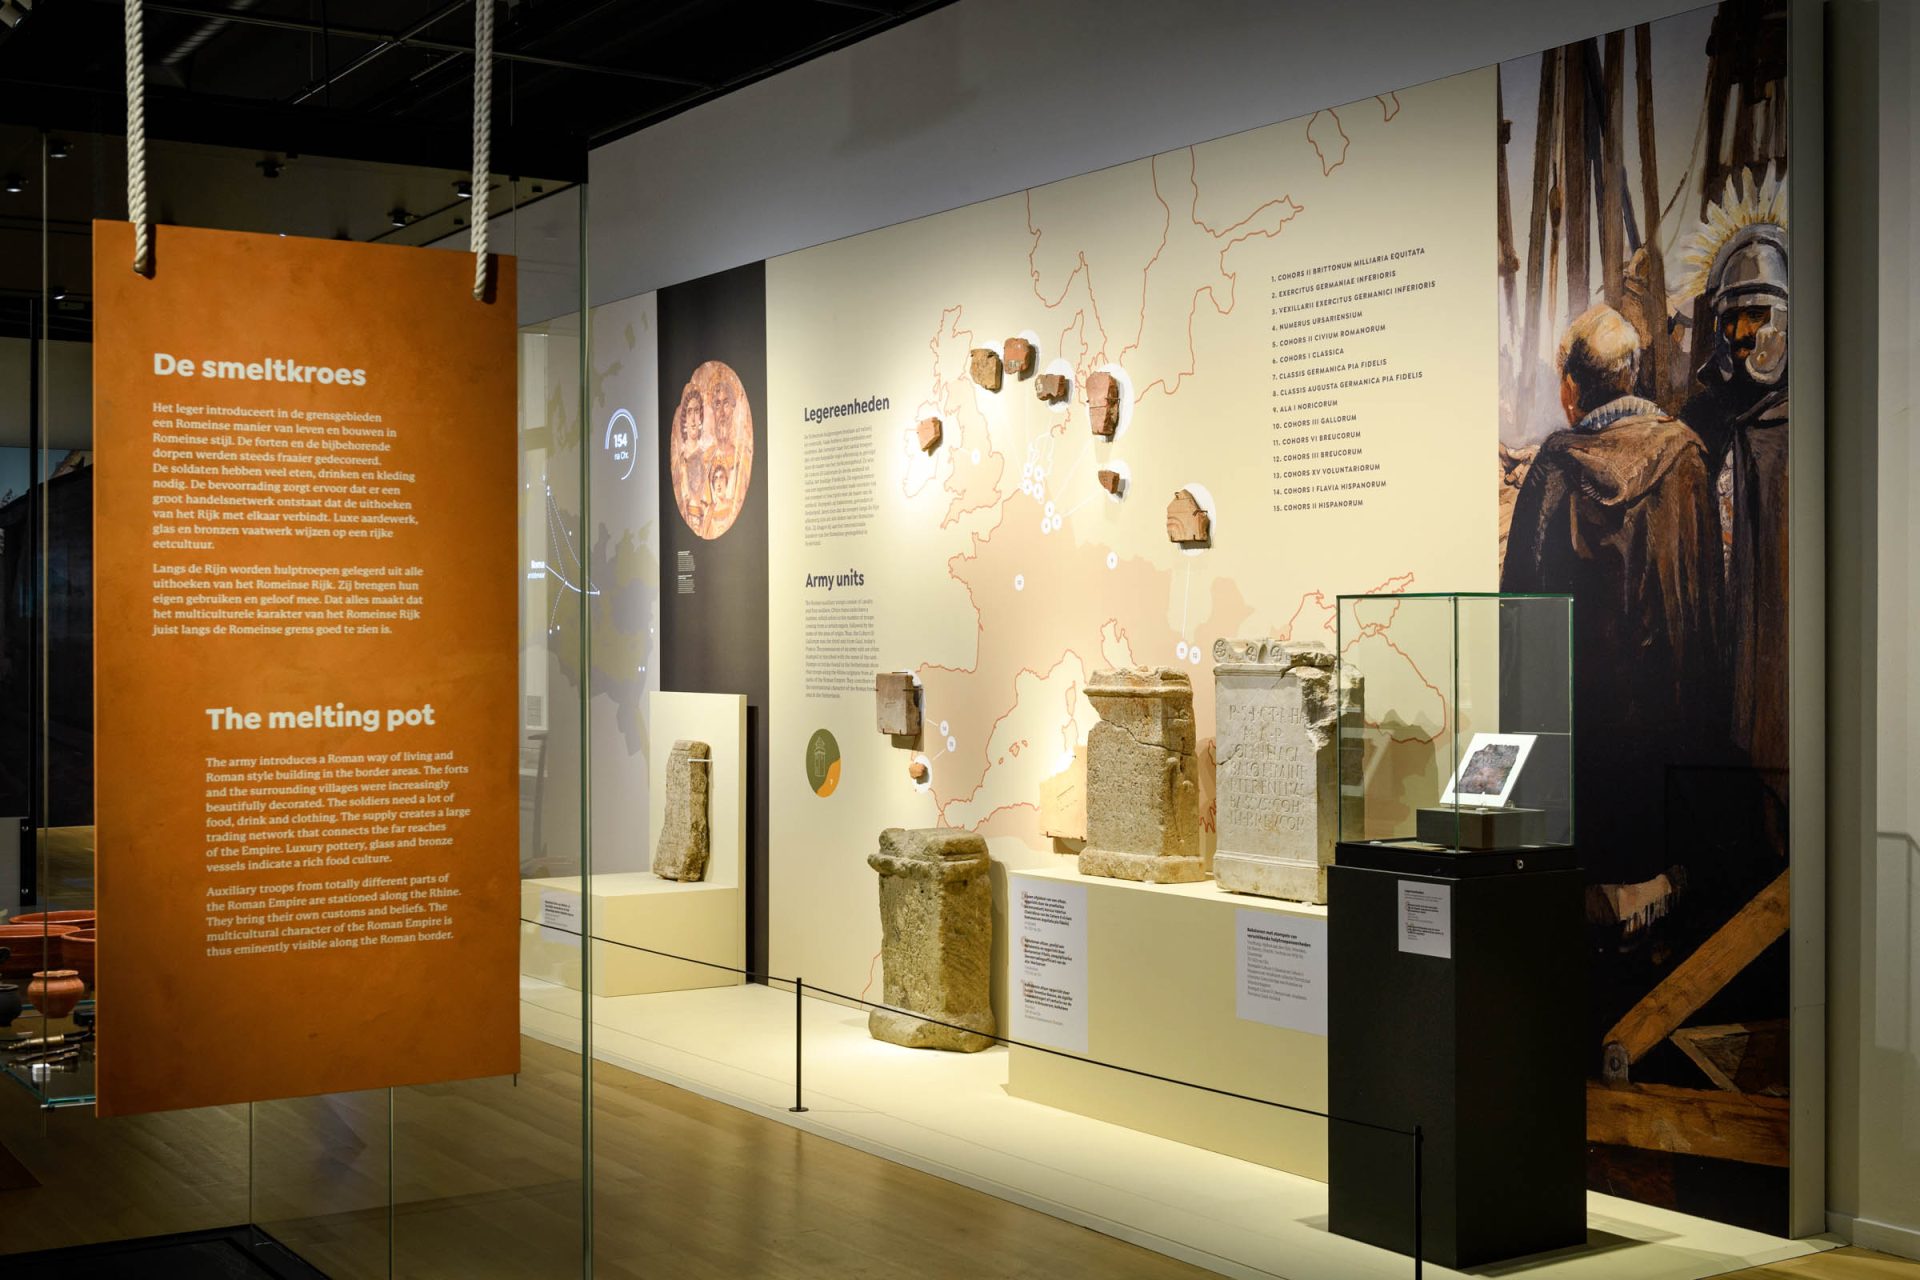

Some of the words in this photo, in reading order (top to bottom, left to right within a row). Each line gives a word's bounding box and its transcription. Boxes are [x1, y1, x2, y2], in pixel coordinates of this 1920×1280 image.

[1277, 270, 1304, 280] COHORS
[1312, 262, 1352, 274] BRITTONUM
[1353, 255, 1388, 266] MILLIARIA
[1390, 249, 1425, 260] EQUITATA
[1278, 286, 1314, 296] EXERCITUS
[1315, 279, 1355, 290] GERMANIAE
[1356, 272, 1396, 283] INFERIORIS
[1278, 302, 1314, 313] VEXILLARII
[1315, 296, 1352, 307] EXERCITUS
[1353, 289, 1392, 300] GERMANICI
[1394, 282, 1435, 294] INFERIORIS
[1279, 320, 1310, 330] NUMERUS
[1312, 312, 1362, 324] URSARIENSIUM
[1279, 337, 1306, 346] COHORS
[1314, 332, 1338, 341] CIVIUM
[1340, 325, 1385, 337] ROMANORUM
[1279, 353, 1306, 363] COHORS
[1311, 349, 1344, 359] CLASSICA
[154, 353, 194, 376] De
[202, 357, 366, 385] smeltkroes
[1278, 370, 1305, 380] CLASSIS
[1306, 365, 1346, 375] GERMANICA
[1347, 362, 1359, 371] PIA
[1360, 359, 1386, 369] FIDELIS
[1279, 386, 1306, 396] CLASSIS
[1307, 382, 1338, 392] AUGUSTA
[1339, 378, 1380, 388] GERMANICA
[1381, 375, 1393, 384] PIA
[1395, 372, 1422, 381] FIDELIS
[152, 403, 173, 413] Het
[175, 404, 203, 417] leger
[206, 405, 274, 417] introduceert
[277, 408, 288, 418] in
[290, 408, 304, 418] de
[305, 409, 381, 423] grensgebieden
[804, 395, 890, 423] Legereenheden
[1279, 405, 1291, 413] ALA
[1297, 400, 1337, 410] NORICORUM
[152, 420, 173, 428] een
[175, 419, 231, 430] Romeinse
[232, 421, 271, 431] manier
[273, 424, 293, 432] van
[295, 423, 324, 434] leven
[326, 426, 340, 434] en
[341, 425, 384, 436] bouwen
[386, 426, 396, 436] in
[1283, 419, 1310, 429] COHORS
[1320, 415, 1356, 425] GALLORUM
[152, 433, 208, 444] Romeinse
[210, 435, 236, 448] stijl.
[237, 436, 253, 446] De
[254, 437, 289, 447] forten
[290, 440, 304, 448] en
[305, 438, 319, 448] de
[321, 439, 390, 453] bijbehorende
[614, 433, 627, 448] 154
[1281, 436, 1309, 445] COHORS
[1318, 432, 1360, 442] BREUCORUM
[152, 448, 193, 461] dorpen
[195, 449, 237, 460] werden
[239, 451, 275, 461] steeds
[277, 452, 312, 462] fraaier
[314, 453, 381, 467] gedecoreerd.
[1282, 453, 1310, 462] COHORS
[1320, 448, 1362, 458] BREUCORUM
[1283, 469, 1310, 478] COHORS
[1322, 464, 1380, 474] VOLUNTARIORUM
[1283, 486, 1310, 495] COHORS
[1316, 484, 1338, 492] FLAVIA
[1340, 481, 1386, 490] HISPANORUM
[1283, 503, 1310, 511] COHORS
[1318, 500, 1362, 509] HISPANORUM
[153, 563, 186, 576] Langs
[187, 564, 202, 574] de
[204, 564, 227, 576] Rijn
[229, 564, 272, 574] worden
[273, 564, 340, 577] hulptroepen
[341, 565, 385, 578] gelegerd
[387, 565, 402, 575] uit
[404, 566, 422, 576] alle
[805, 572, 834, 591] Army
[836, 568, 865, 587] units
[206, 706, 261, 730] The
[268, 702, 380, 732] melting
[386, 704, 435, 731] pot
[206, 756, 227, 767] The
[228, 758, 257, 768] army
[259, 754, 317, 765] introduces
[318, 755, 326, 764] a
[327, 752, 365, 763] Roman
[366, 754, 388, 764] way
[389, 751, 401, 761] of
[403, 750, 433, 763] living
[433, 750, 453, 760] and
[205, 770, 245, 781] Roman
[246, 769, 274, 782] style
[275, 768, 321, 781] building
[322, 768, 333, 778] in
[335, 767, 353, 777] the
[354, 766, 390, 777] border
[391, 767, 420, 775] areas.
[423, 764, 443, 775] The
[444, 764, 468, 774] forts
[206, 786, 227, 797] and
[229, 786, 247, 796] the
[249, 784, 316, 797] surrounding
[318, 782, 358, 795] villages
[360, 783, 386, 791] were
[388, 779, 448, 792] increasingly
[206, 884, 257, 898] Auxiliary
[259, 882, 294, 895] troops
[296, 880, 323, 891] from
[324, 878, 360, 891] totally
[361, 876, 407, 887] different
[409, 874, 436, 887] parts
[437, 873, 449, 883] of
